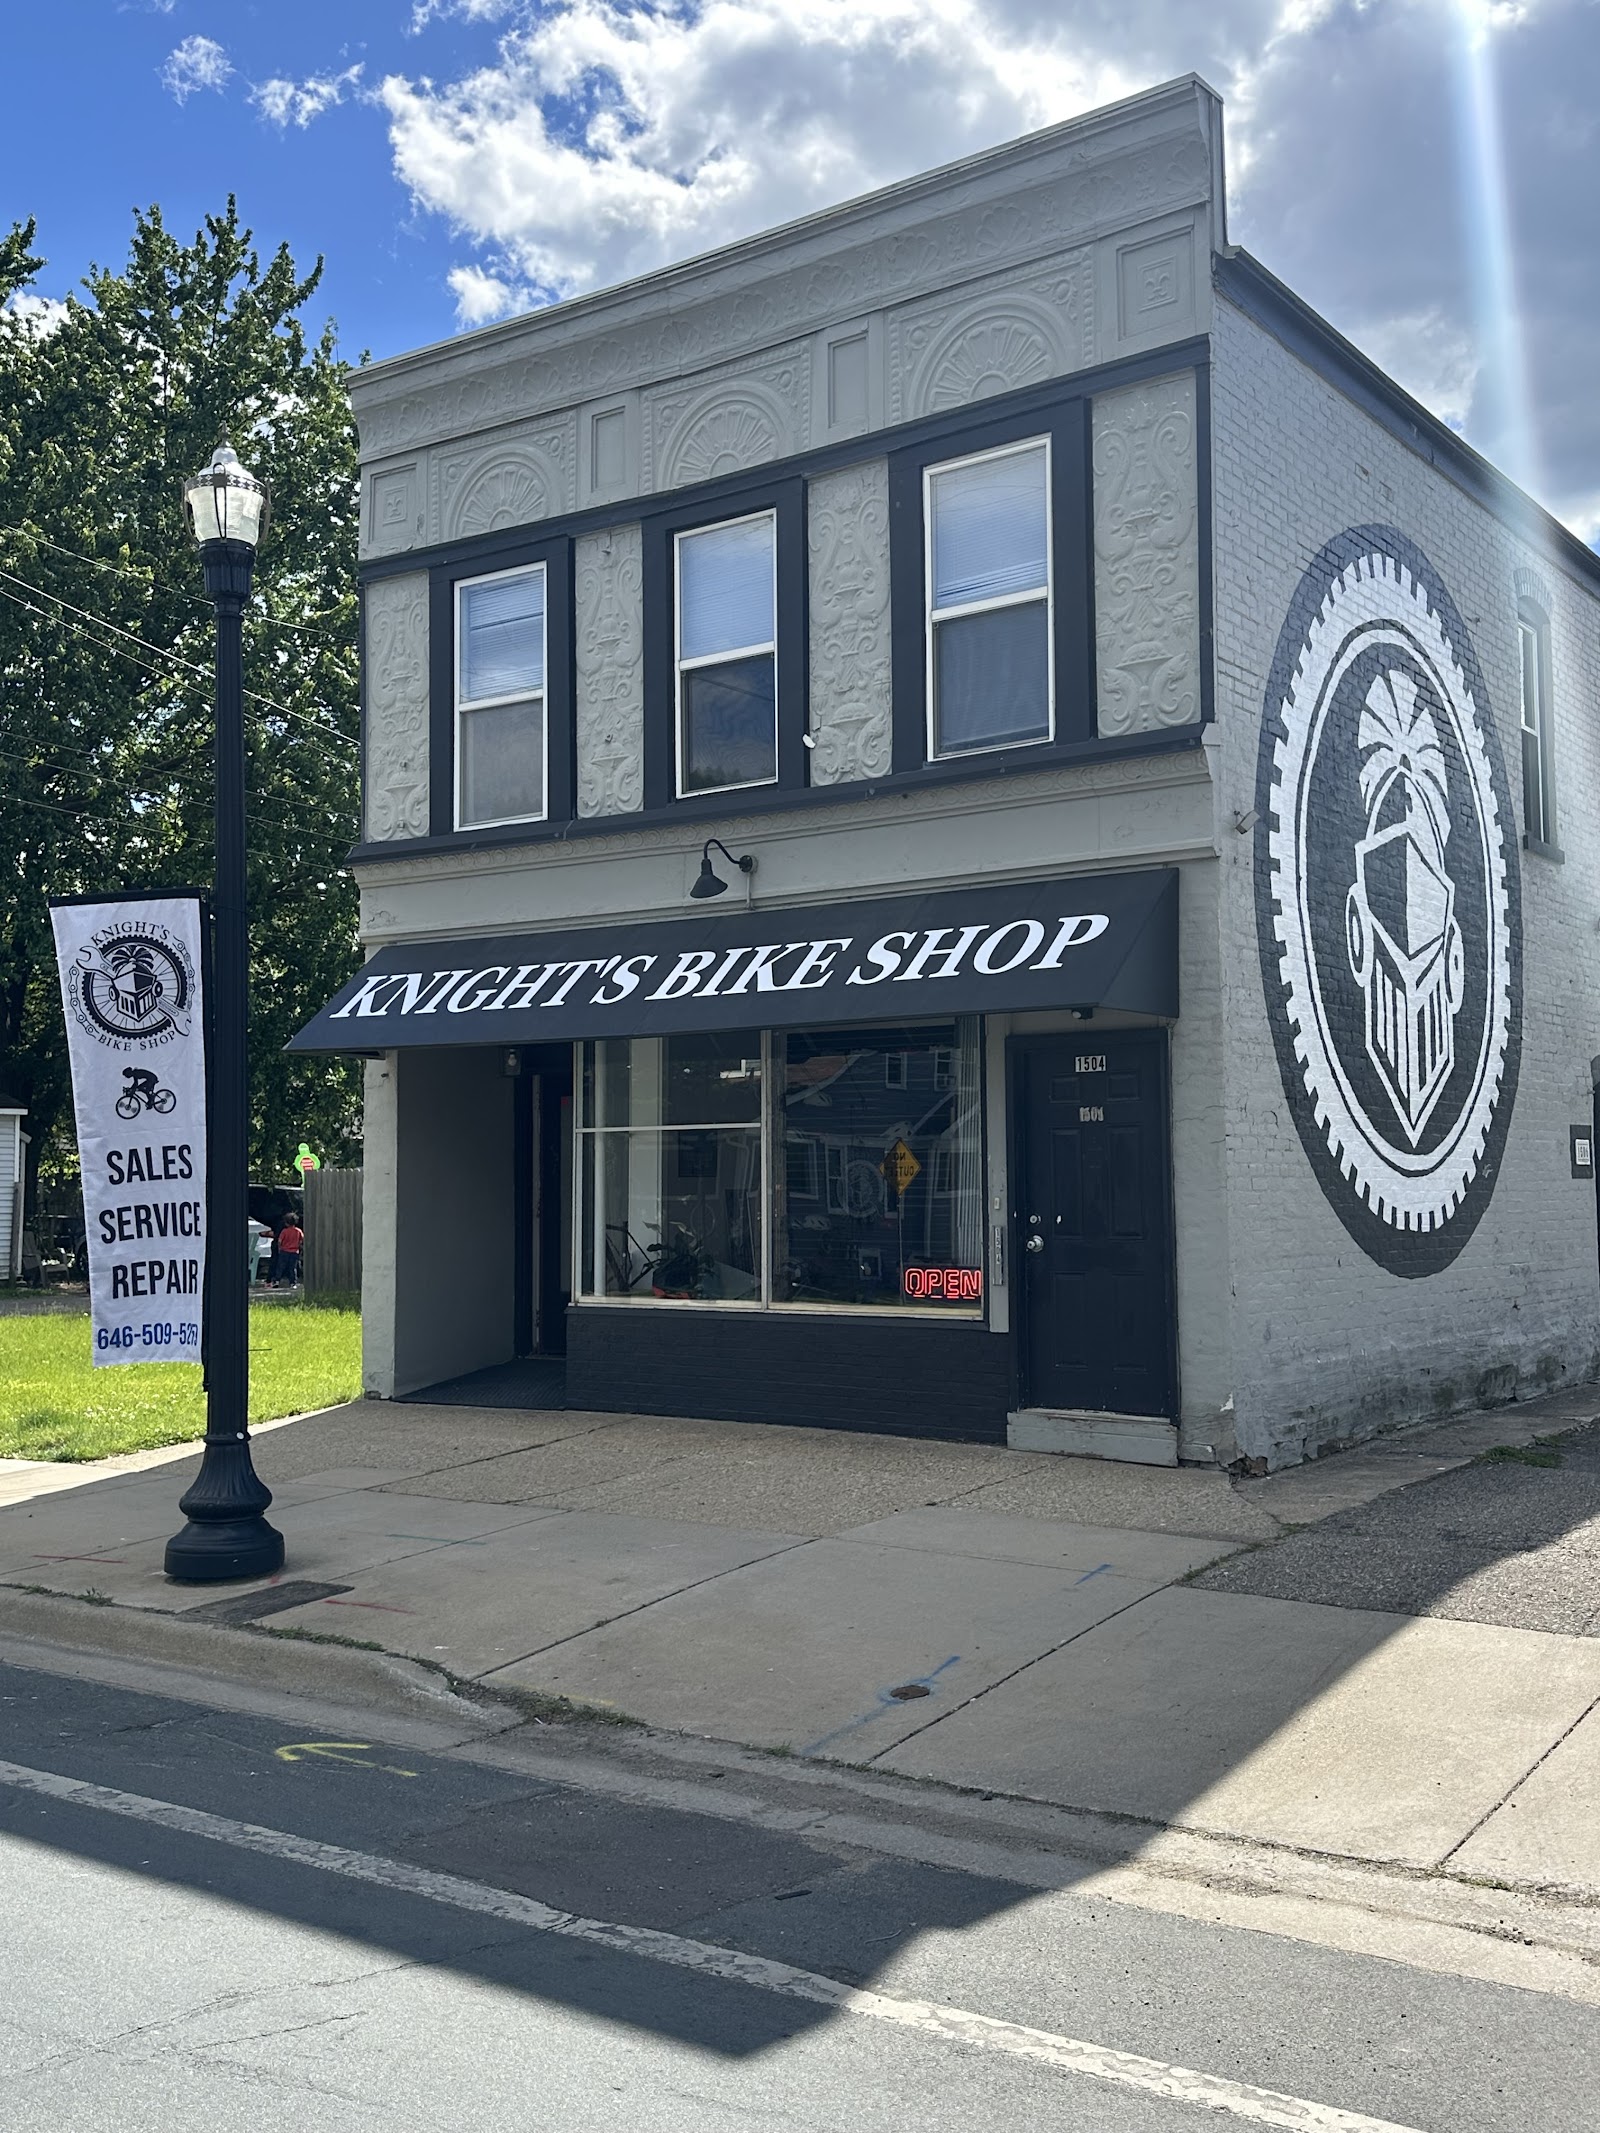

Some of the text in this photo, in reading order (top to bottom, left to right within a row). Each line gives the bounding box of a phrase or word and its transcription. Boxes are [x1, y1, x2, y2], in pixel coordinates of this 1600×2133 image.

[91, 921, 171, 947] KNIGHT'S
[330, 915, 1110, 1018] KNIGHT'S BIKE SHOP
[97, 1031, 176, 1052] BIKE SHOP
[1077, 1056, 1105, 1071] 1504
[107, 1145, 193, 1185] SALES
[99, 1202, 202, 1244] SERVICE
[113, 1259, 198, 1299] REPAIR
[905, 1267, 982, 1298] OPEN
